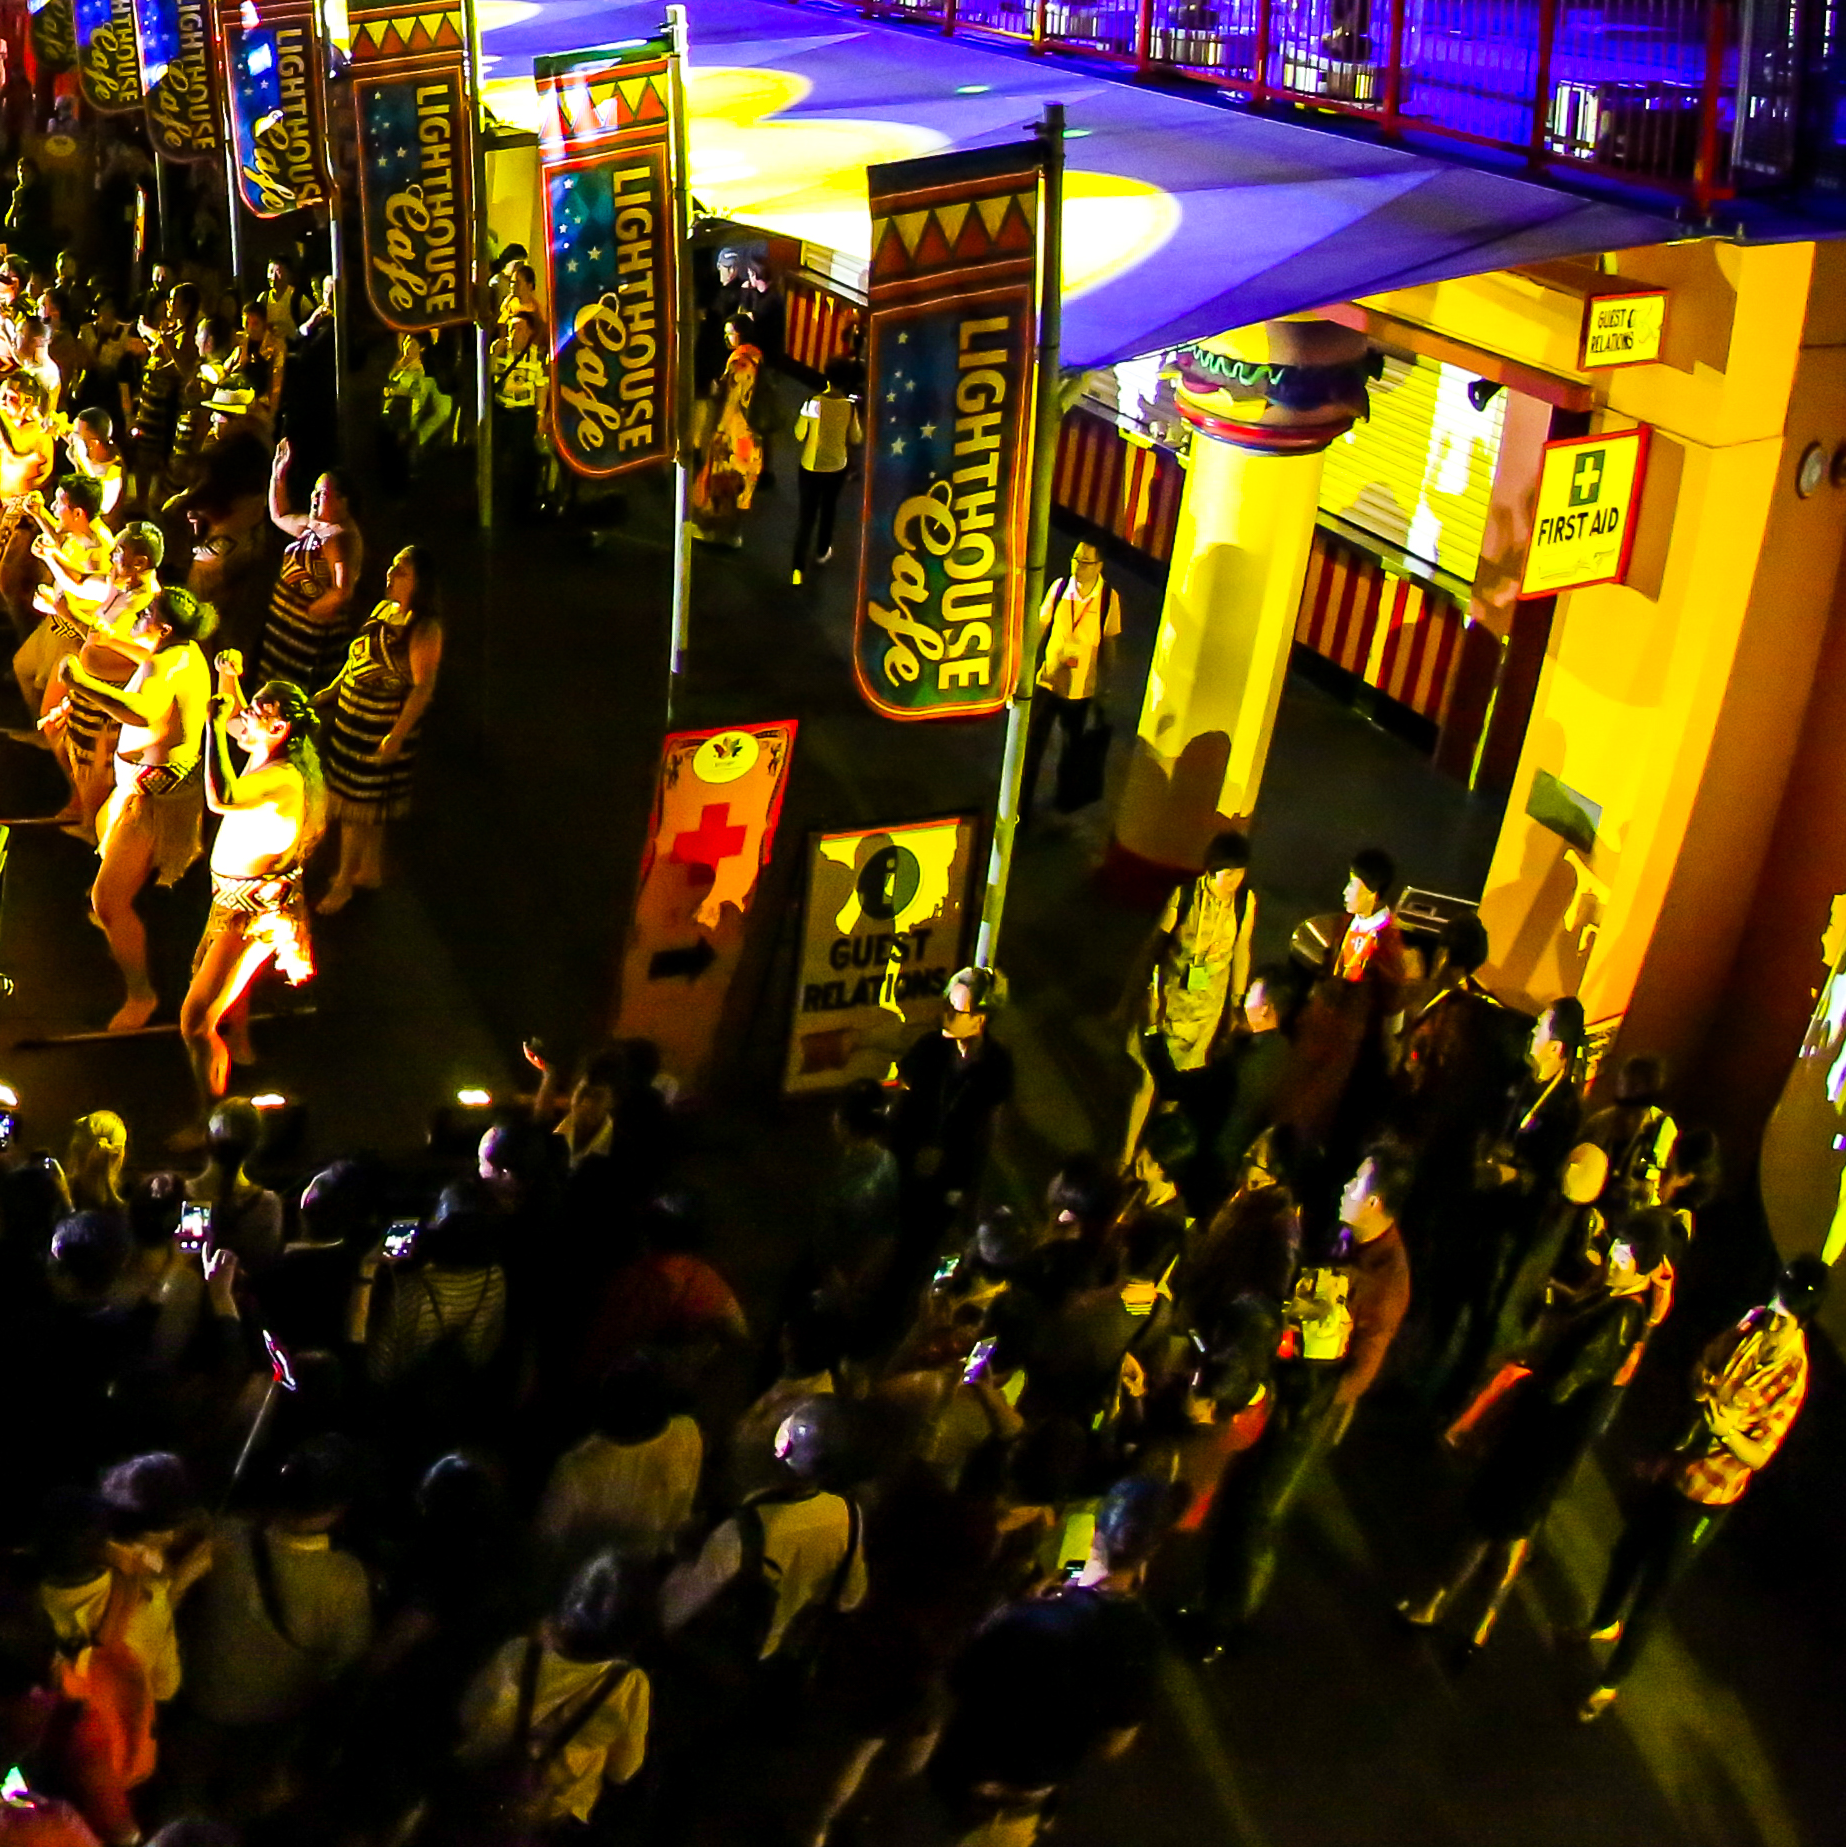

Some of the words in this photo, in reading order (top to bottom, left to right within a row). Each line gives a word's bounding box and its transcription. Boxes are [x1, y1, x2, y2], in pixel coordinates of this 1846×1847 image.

[85, 22, 119, 100] Cafe
[150, 60, 193, 148] Cafe
[243, 109, 296, 209] Cafe
[415, 83, 457, 313] LIGHTHOUSE
[373, 183, 431, 311] Cafe
[612, 165, 657, 452] LIGHTHOUSE
[1589, 331, 1634, 354] RELATIONS
[1597, 308, 1625, 330] GUEST
[559, 292, 627, 452] Cafe
[937, 315, 1010, 691] LIGHTHOUSE
[1537, 511, 1589, 547] FIRST
[1589, 506, 1619, 537] AID
[867, 479, 958, 688] Cafe
[801, 967, 948, 1013] RELATIONS
[829, 927, 934, 971] GUEST
